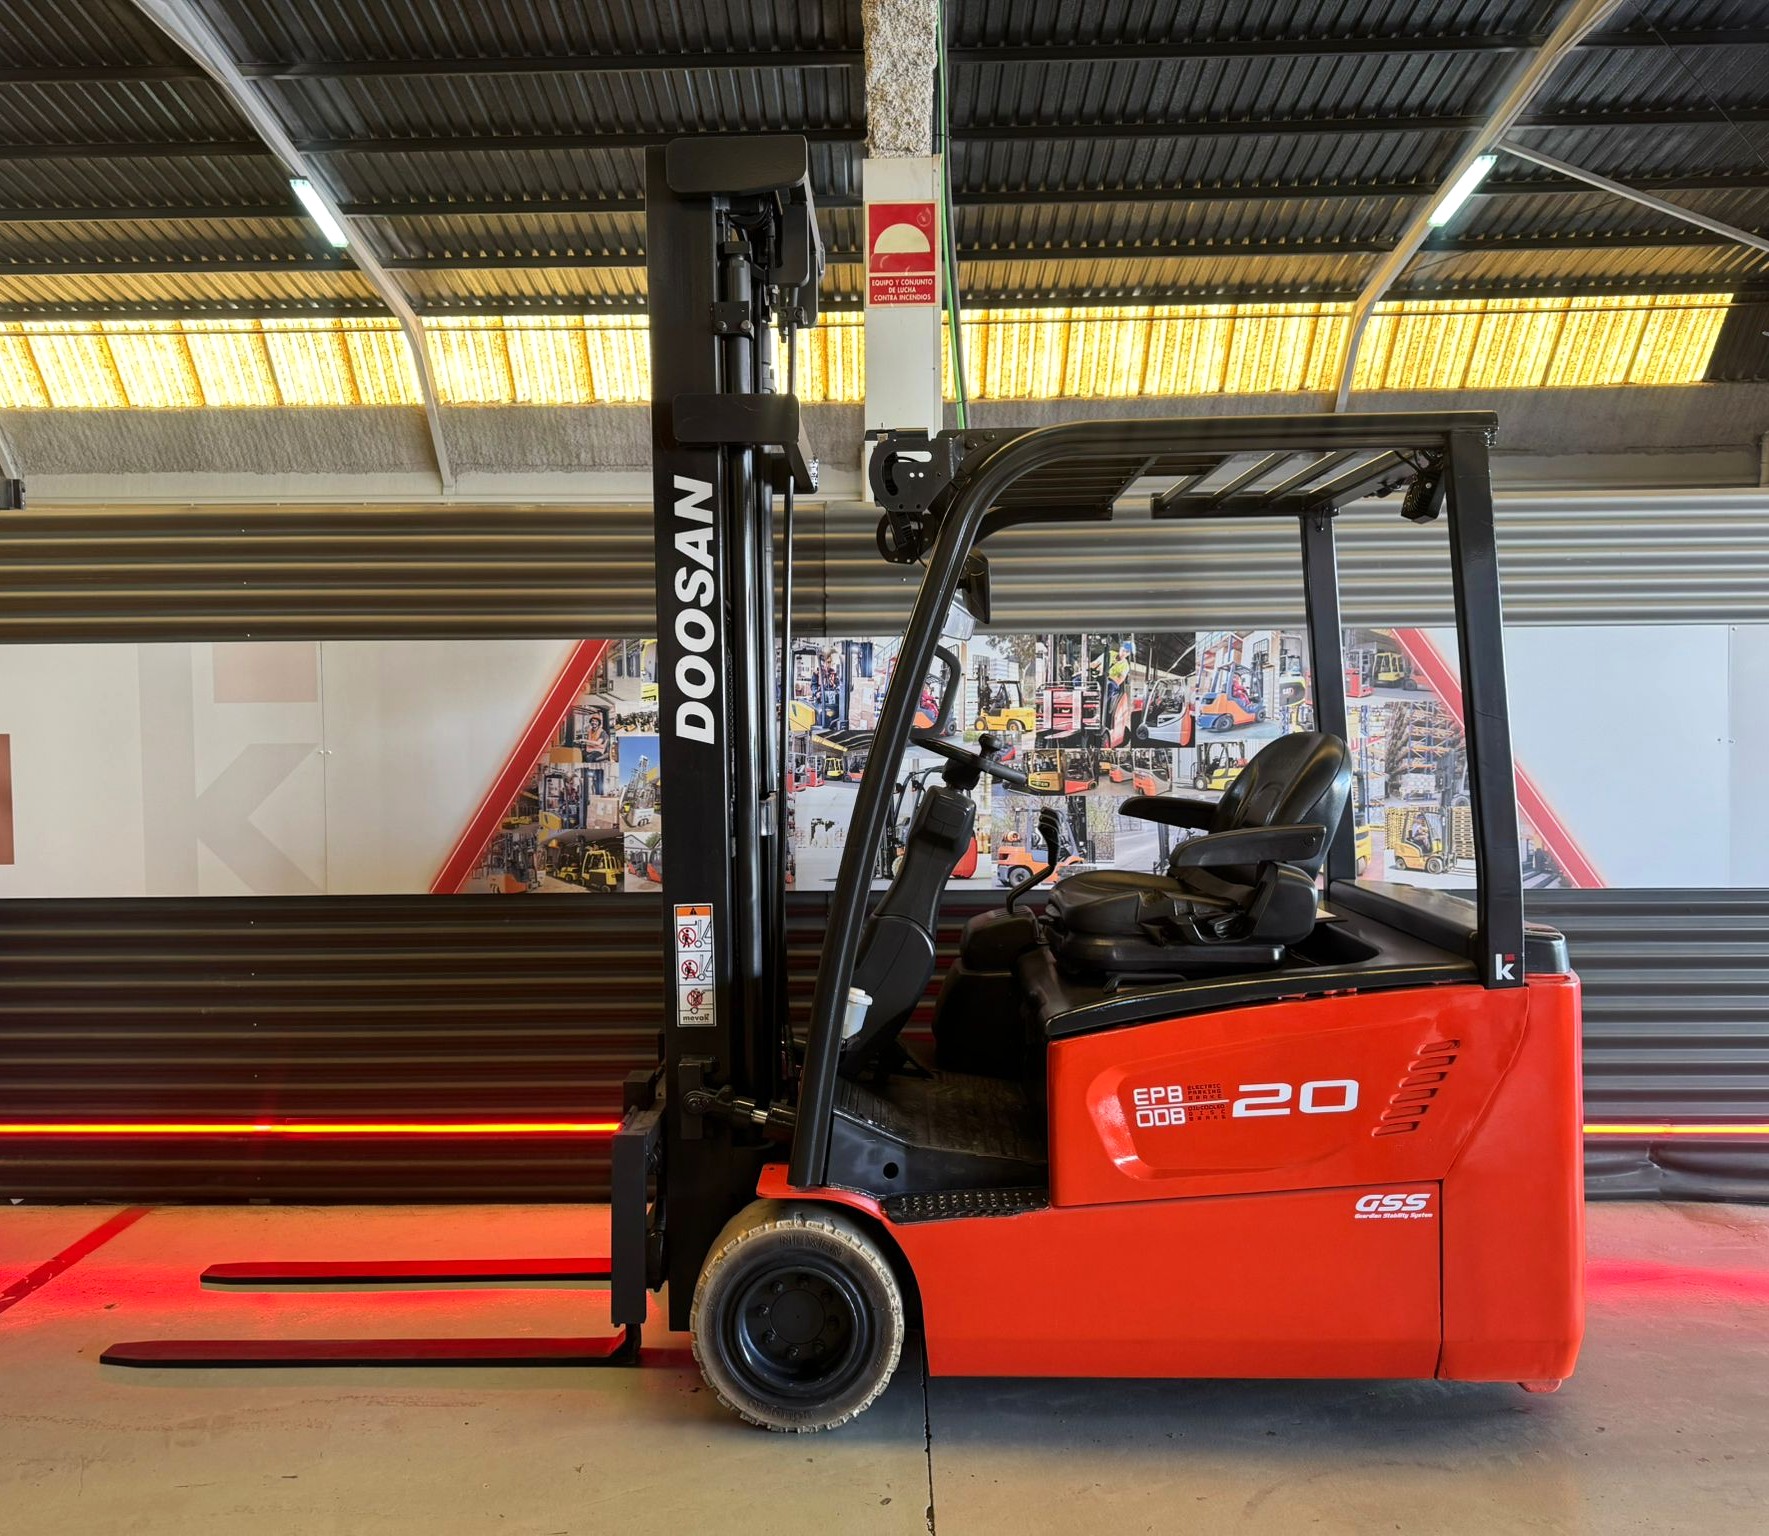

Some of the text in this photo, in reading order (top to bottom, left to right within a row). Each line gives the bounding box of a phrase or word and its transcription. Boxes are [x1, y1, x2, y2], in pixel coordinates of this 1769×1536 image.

[900, 278, 933, 286] CONJUNTO
[897, 286, 916, 294] LUCHA
[673, 474, 715, 745] DOOSAN
[1187, 1083, 1221, 1091] ELECTRIC
[1133, 1085, 1183, 1106] EPB
[1232, 1079, 1359, 1118] 20
[1187, 1103, 1225, 1111] OIL-COOLED
[1355, 1193, 1431, 1212] GSS
[1409, 1212, 1433, 1220] System
